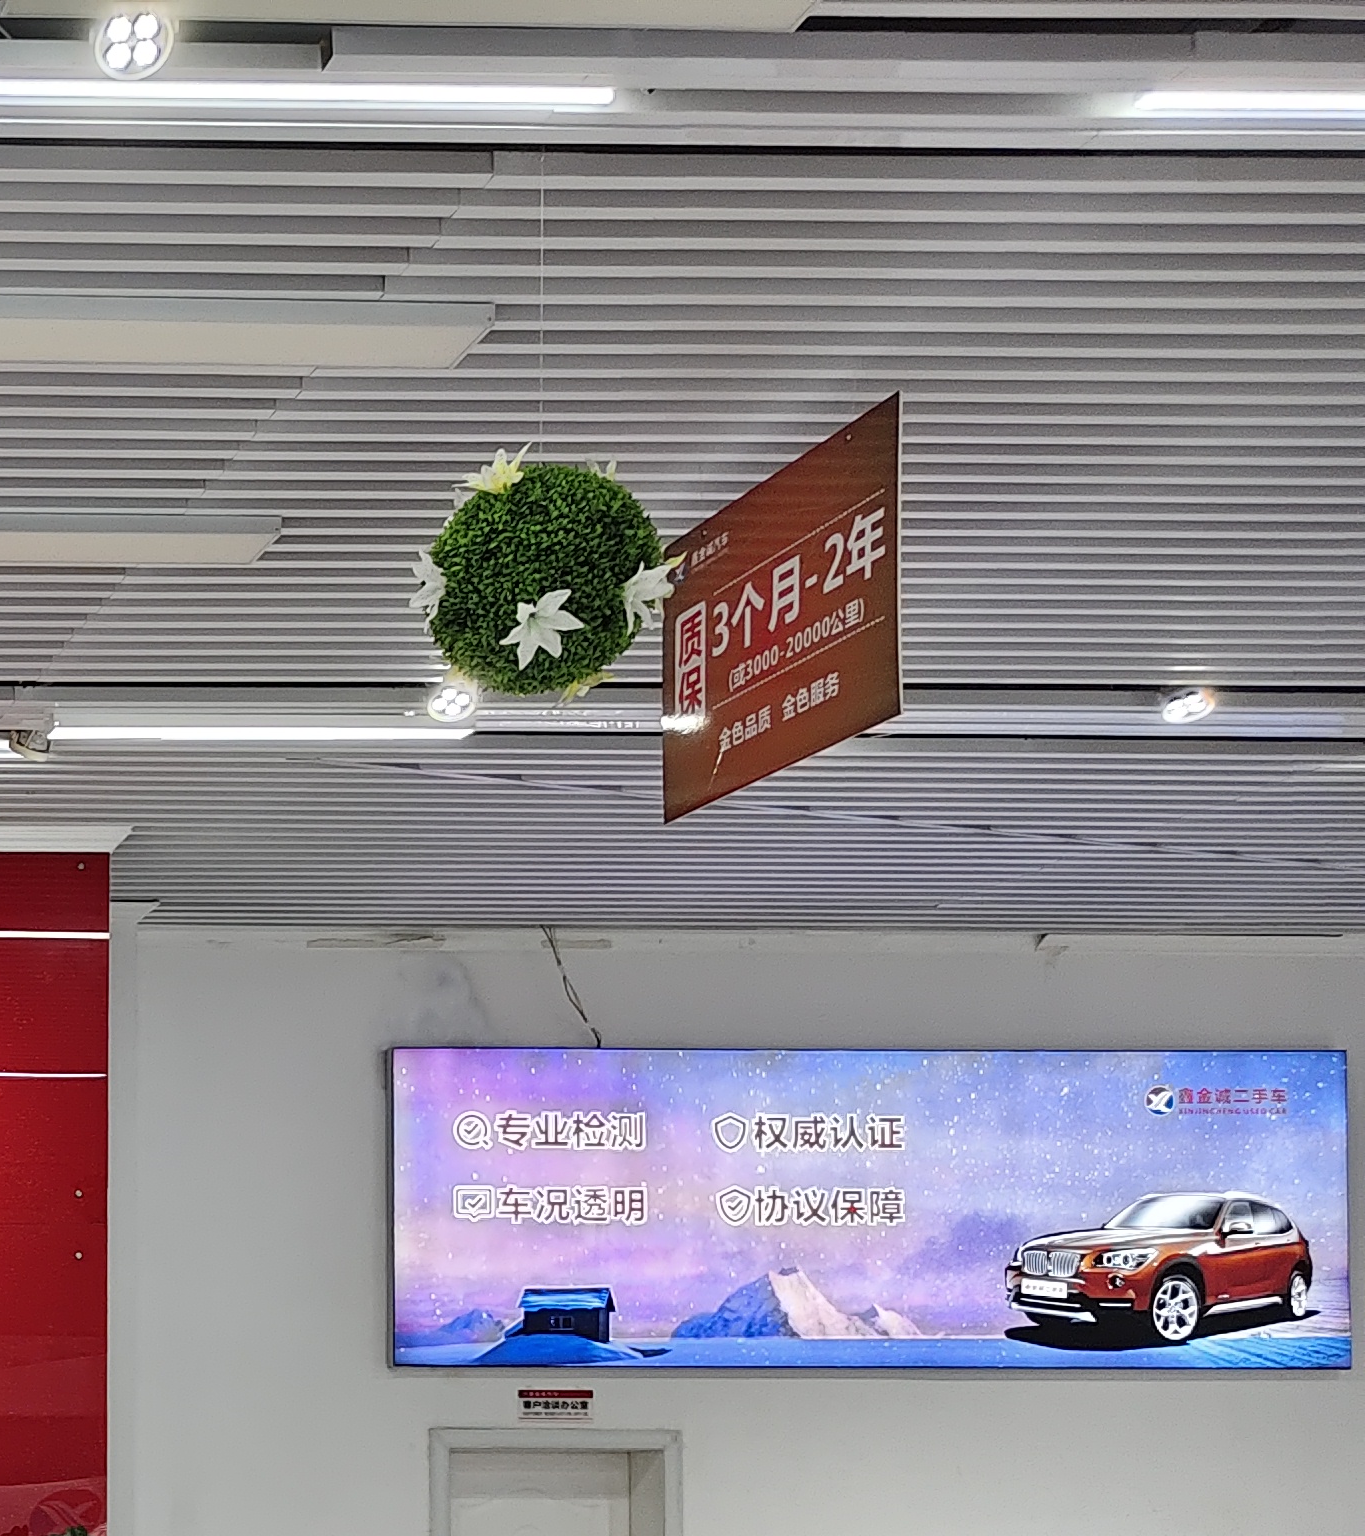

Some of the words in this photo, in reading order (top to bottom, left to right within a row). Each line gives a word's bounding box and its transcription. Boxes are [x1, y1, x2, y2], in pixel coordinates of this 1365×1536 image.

[678, 608, 703, 716] 质保
[728, 598, 864, 692] (或3000-20000公里)
[718, 705, 771, 752] 金色品质
[781, 671, 840, 722] 金色服务
[495, 1112, 647, 1152] 专业检测
[754, 1112, 908, 1152] 权威认证
[495, 1187, 648, 1227] 车况透明
[754, 1187, 908, 1227] 协议保障
